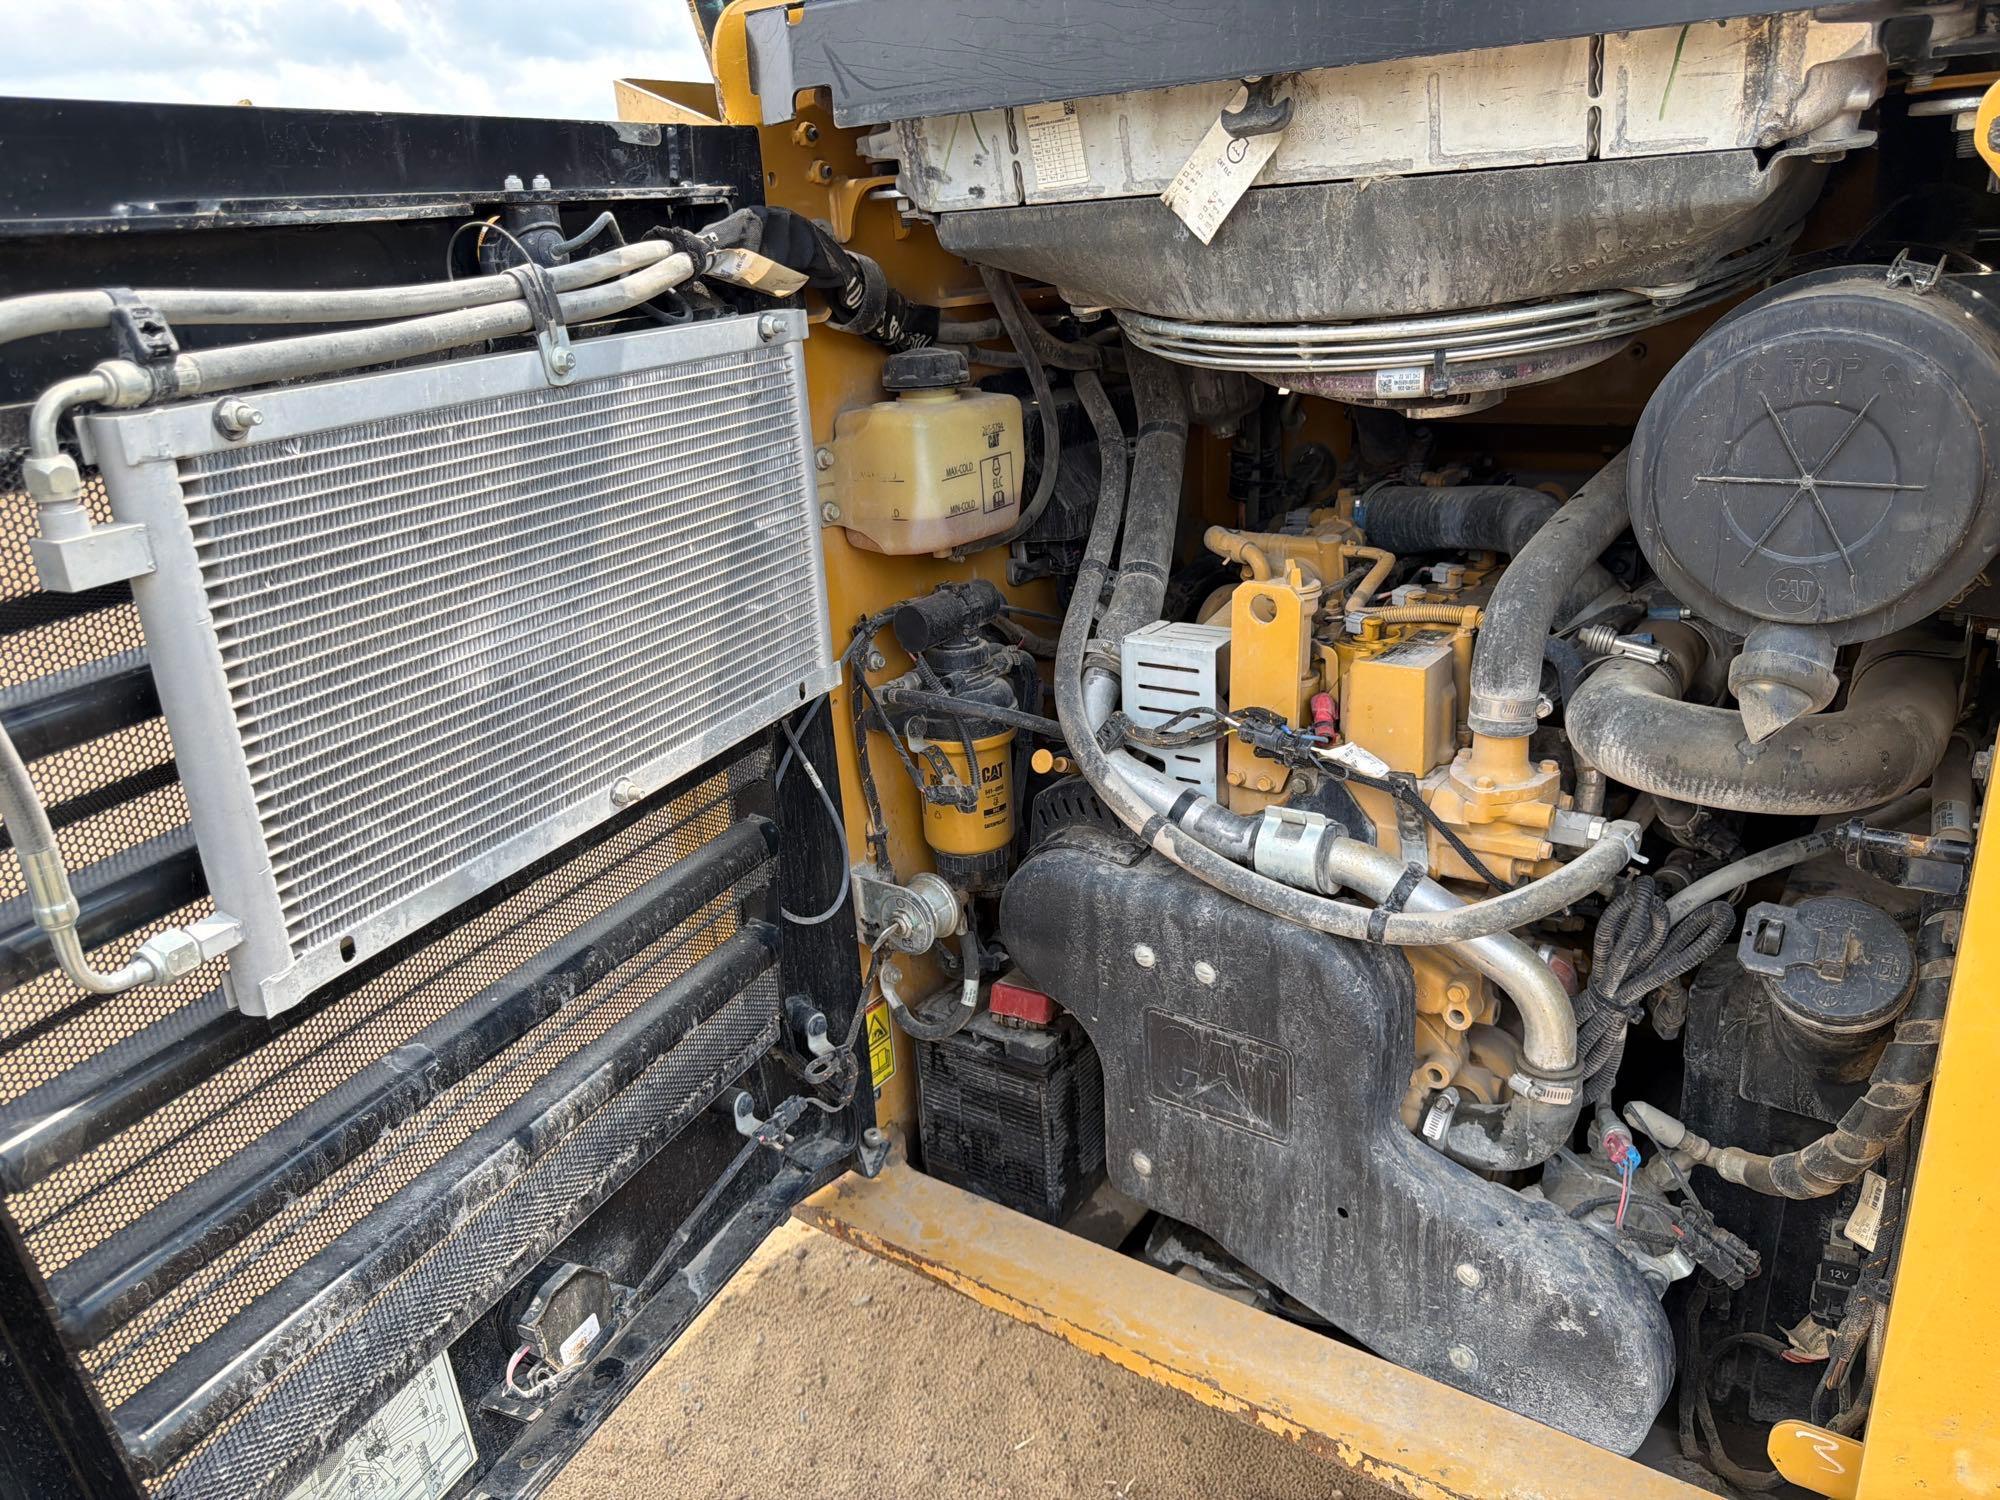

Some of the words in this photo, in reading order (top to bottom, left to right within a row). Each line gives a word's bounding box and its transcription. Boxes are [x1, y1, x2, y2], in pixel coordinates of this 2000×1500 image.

[1785, 357, 1864, 385] TOP
[988, 433, 1000, 448] CAT
[946, 462, 974, 477] MAX-COLD
[992, 476, 1004, 489] ELC
[950, 500, 976, 514] MIN-COLD
[1775, 578, 1815, 603] CAT
[981, 762, 1003, 783] CAT
[1160, 1025, 1281, 1131] CAT
[1829, 1269, 1850, 1280] 12V
